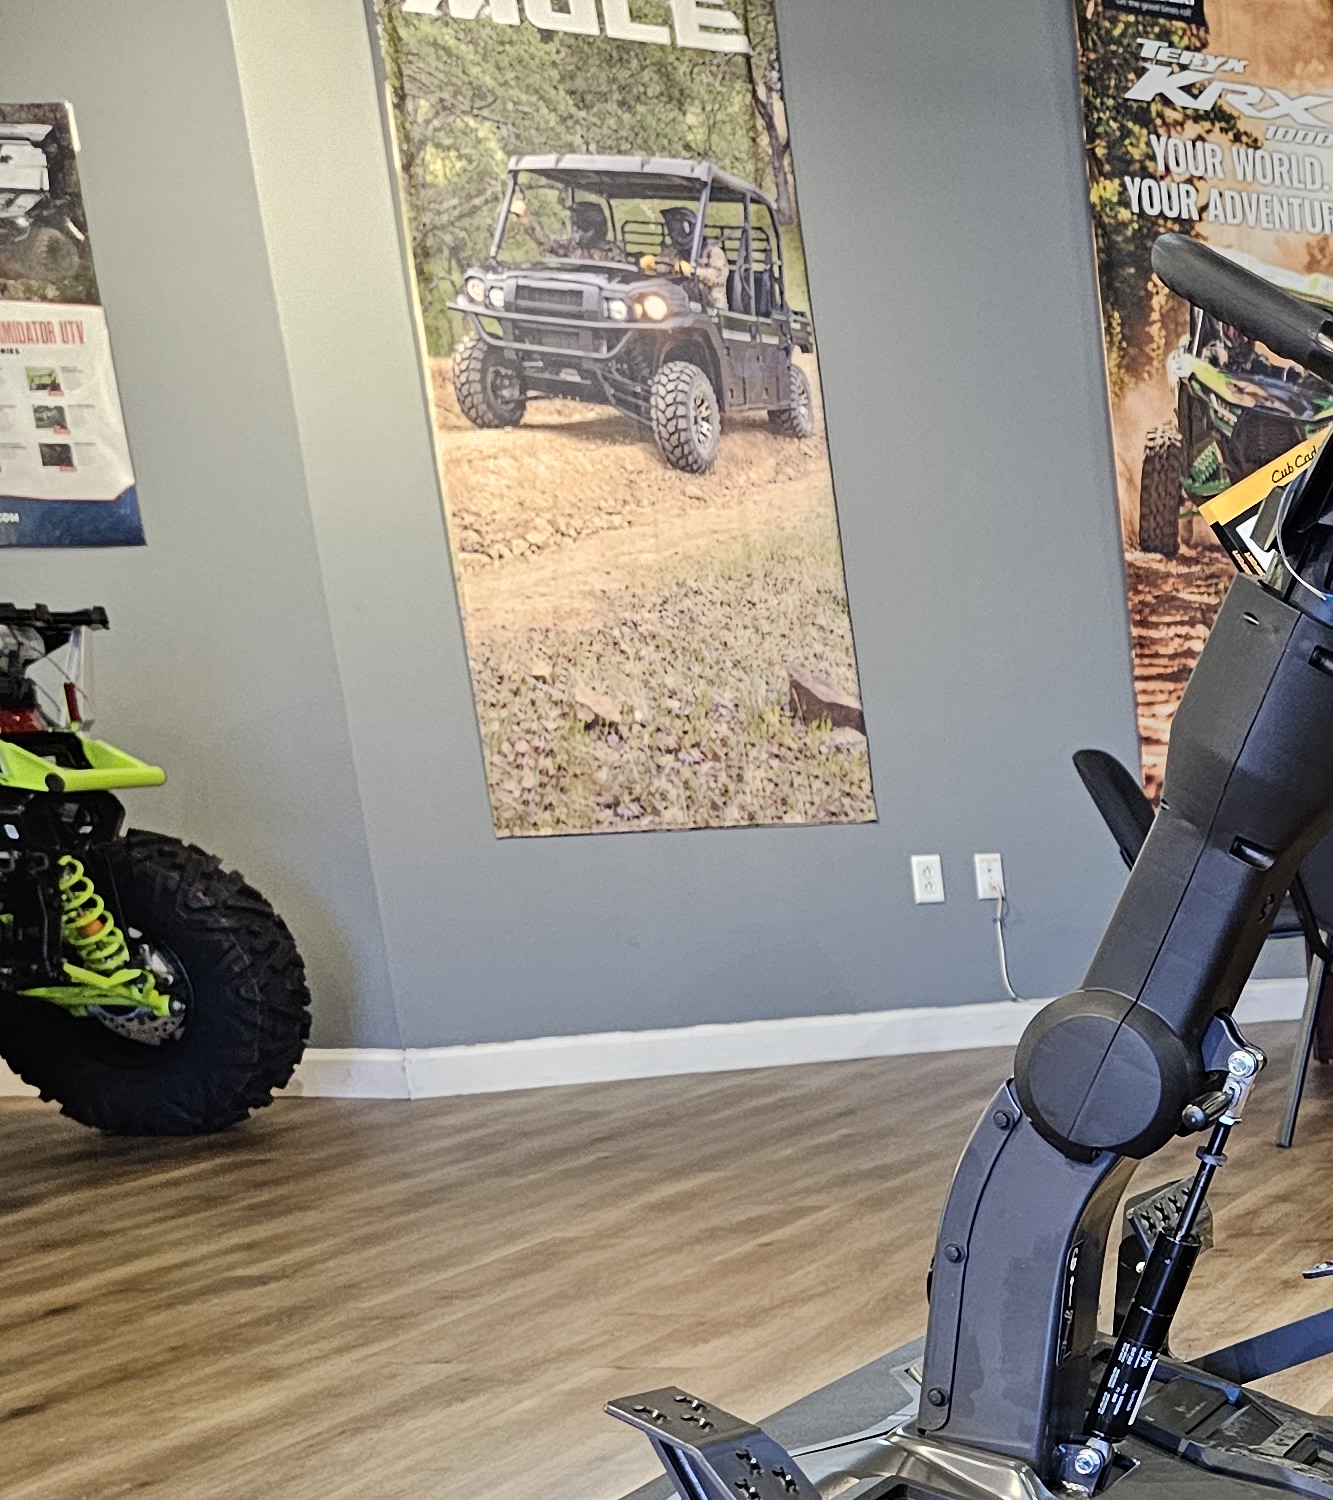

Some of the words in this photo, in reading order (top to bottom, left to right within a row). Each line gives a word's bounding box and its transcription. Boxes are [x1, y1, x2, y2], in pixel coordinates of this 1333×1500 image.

[1136, 38, 1249, 74] TERYX
[1150, 134, 1225, 180] YOUR
[1232, 145, 1330, 193] WORLD.
[1124, 176, 1199, 221] YOUR
[1271, 464, 1295, 483] Cub
